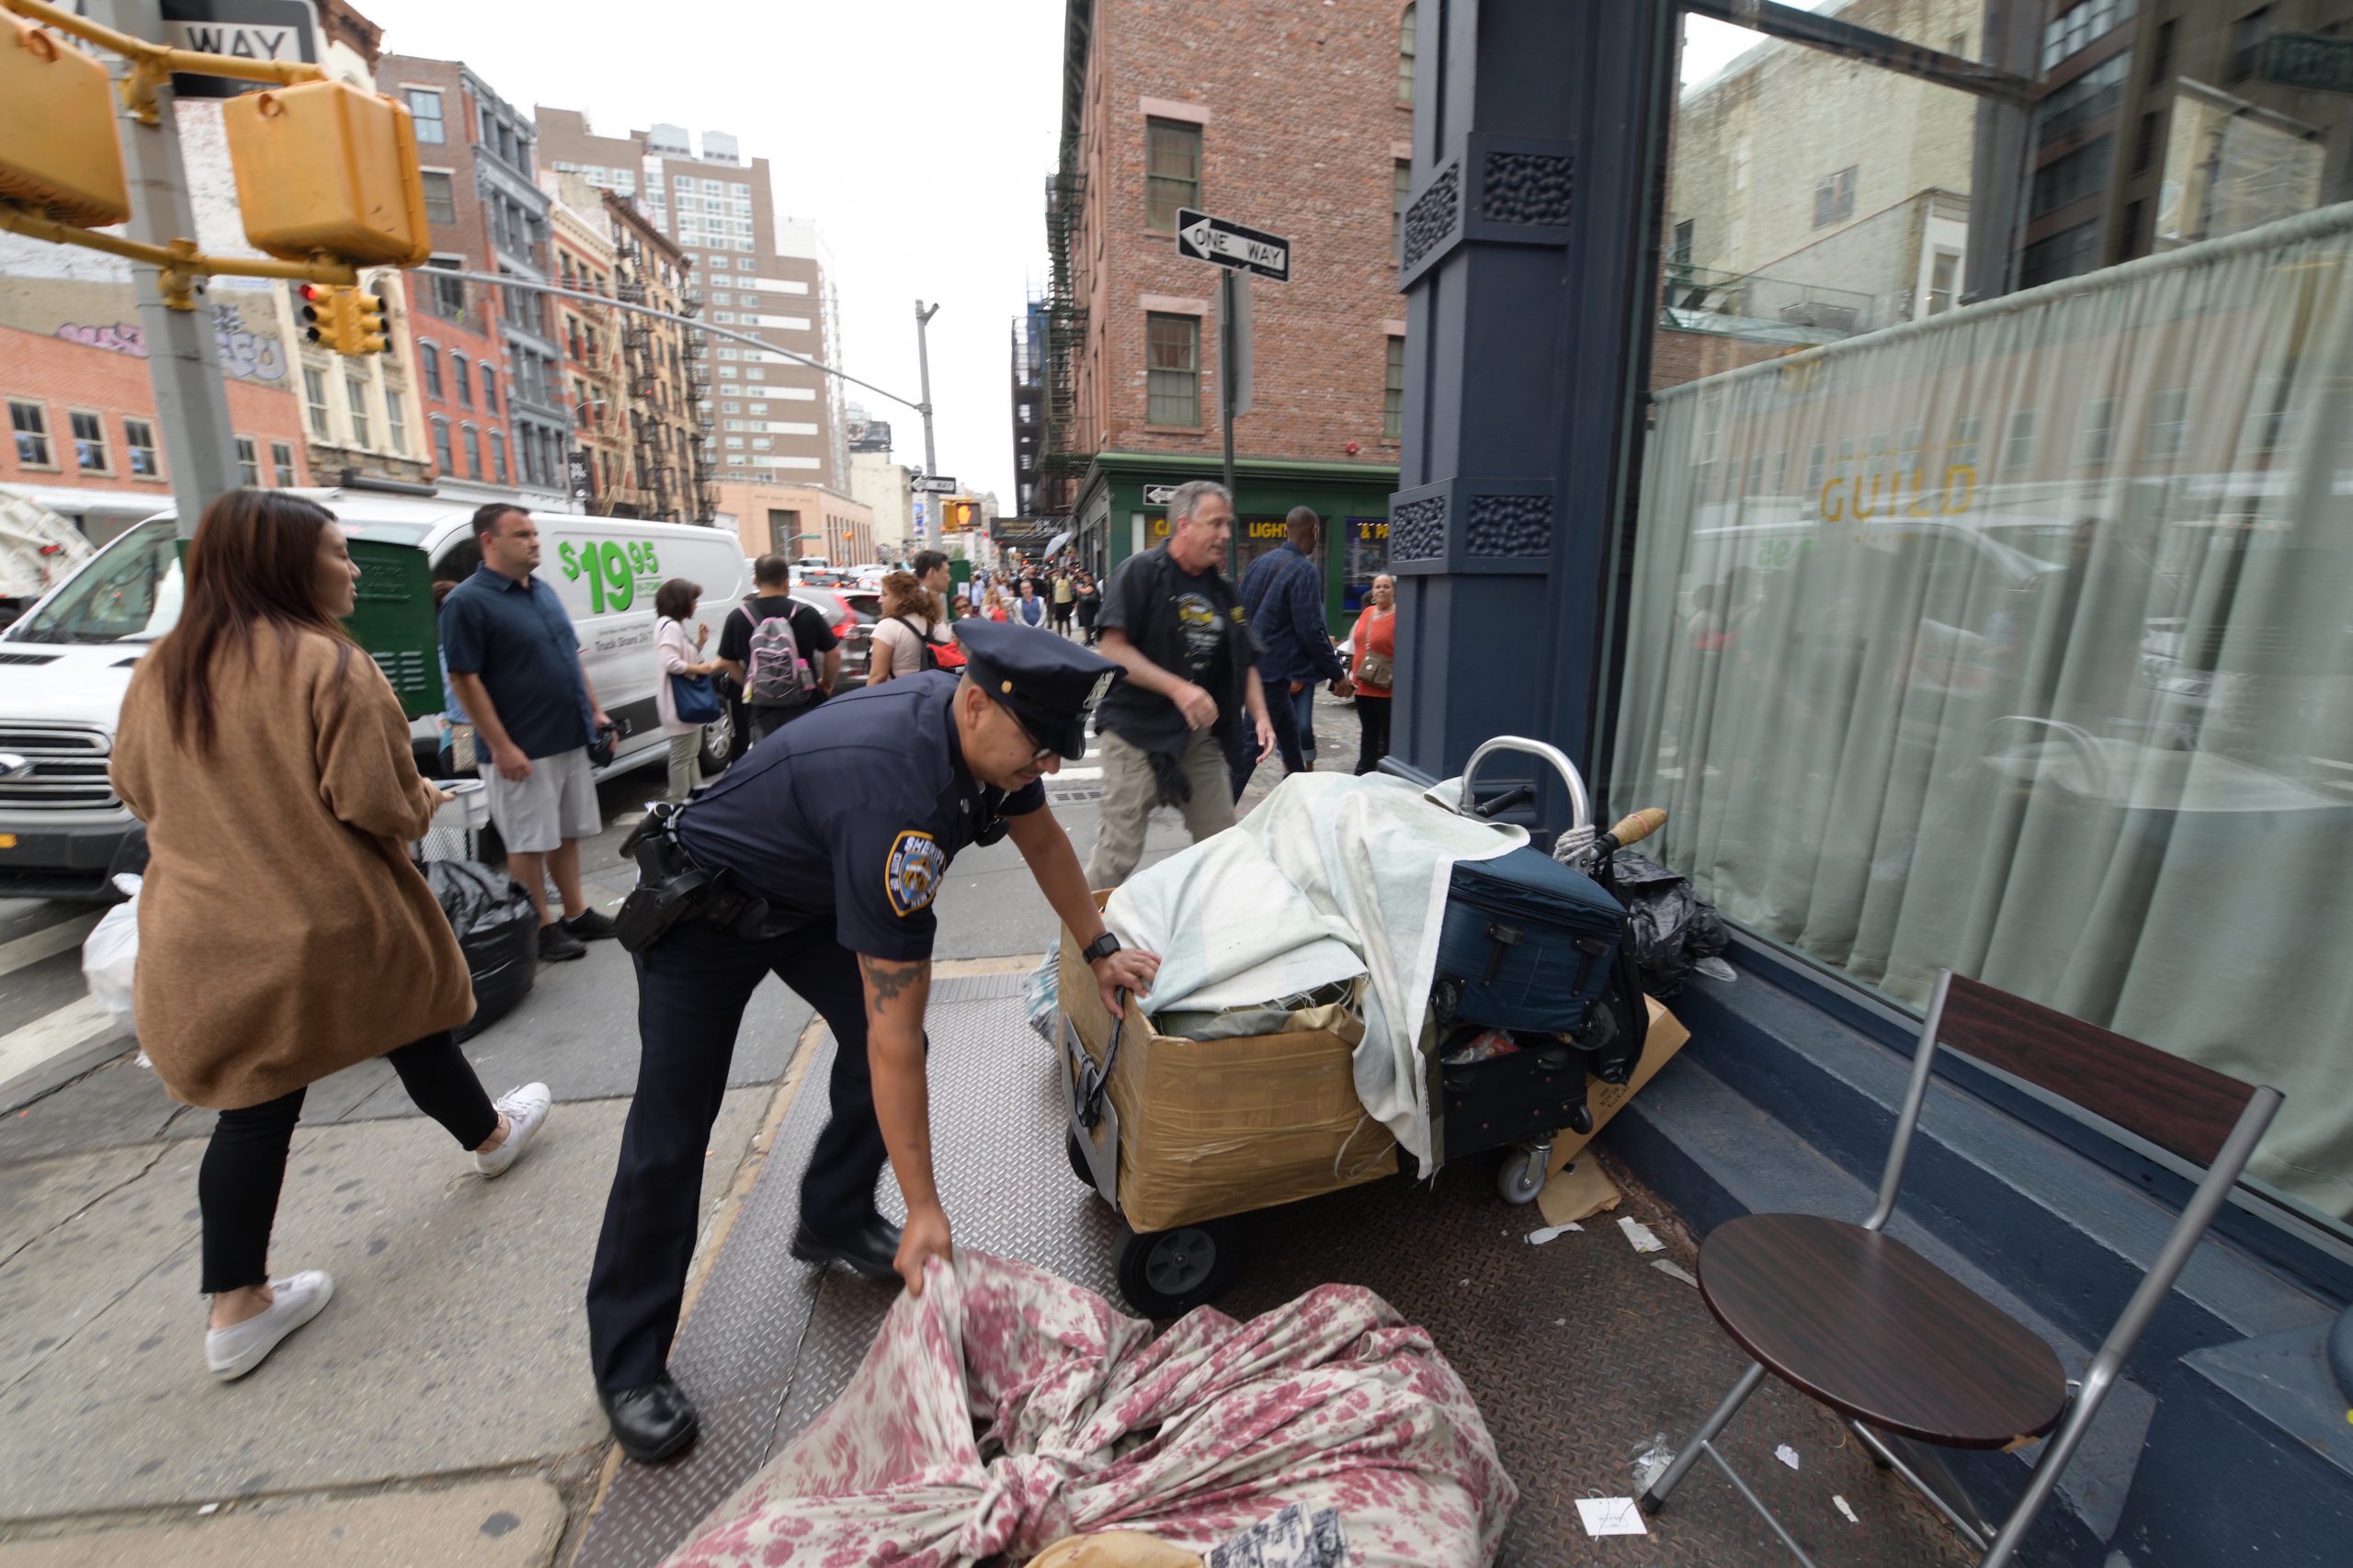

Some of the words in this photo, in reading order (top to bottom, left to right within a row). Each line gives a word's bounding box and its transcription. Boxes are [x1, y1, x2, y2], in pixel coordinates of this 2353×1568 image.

[188, 27, 286, 60] WAY
[1195, 228, 1228, 252] ONE
[1246, 242, 1280, 266] WAY
[1820, 465, 1976, 522] GUILD
